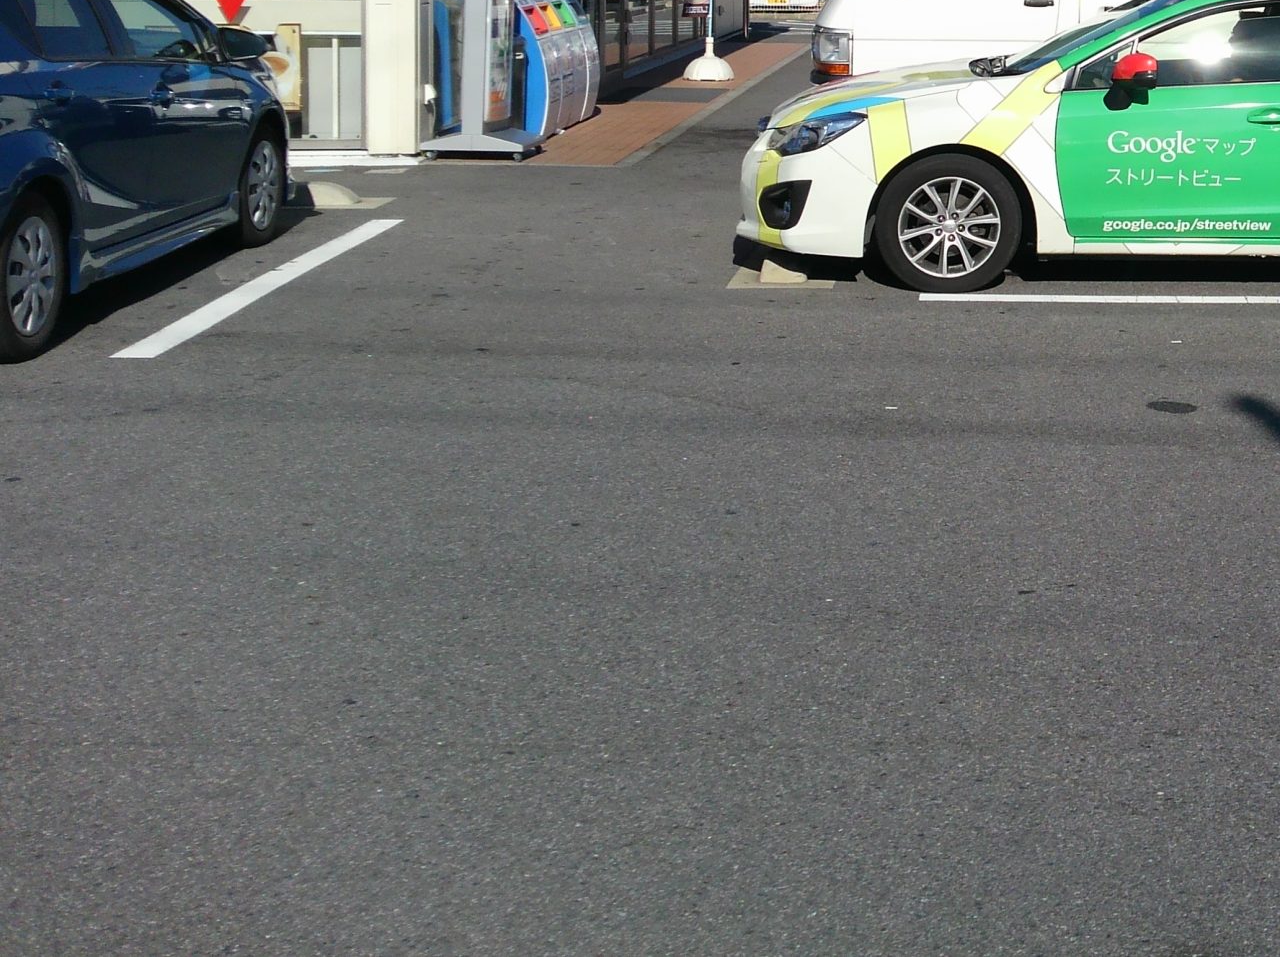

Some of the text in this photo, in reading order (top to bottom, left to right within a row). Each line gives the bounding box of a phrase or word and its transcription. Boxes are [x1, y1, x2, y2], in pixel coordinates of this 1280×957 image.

[1107, 130, 1257, 162] Google マップ
[1105, 168, 1242, 187] ストリートビュー
[1102, 218, 1272, 232] google.co.jp/streetview
